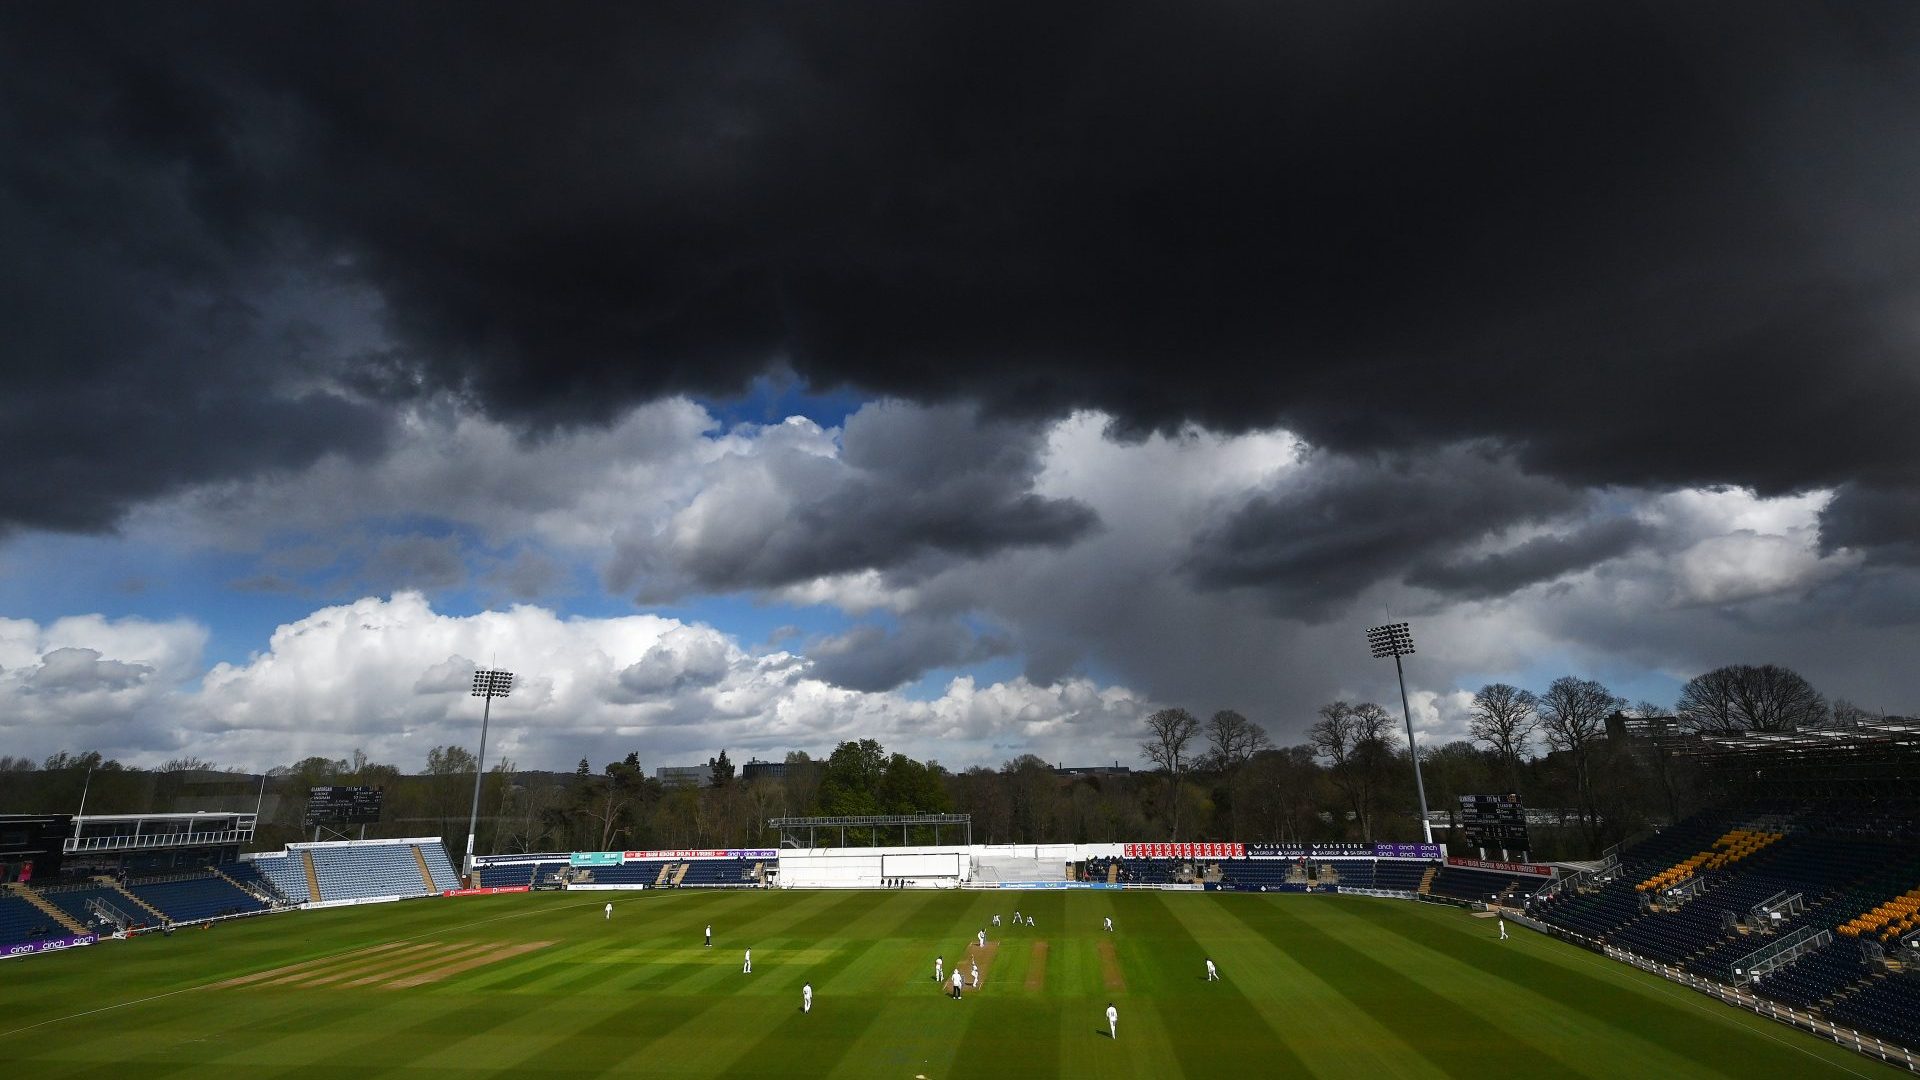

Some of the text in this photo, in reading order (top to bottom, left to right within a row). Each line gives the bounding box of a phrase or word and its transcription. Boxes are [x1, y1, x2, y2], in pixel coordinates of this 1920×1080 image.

[73, 936, 93, 944] cinch
[43, 940, 64, 949] cinch
[11, 945, 33, 953] cinch
